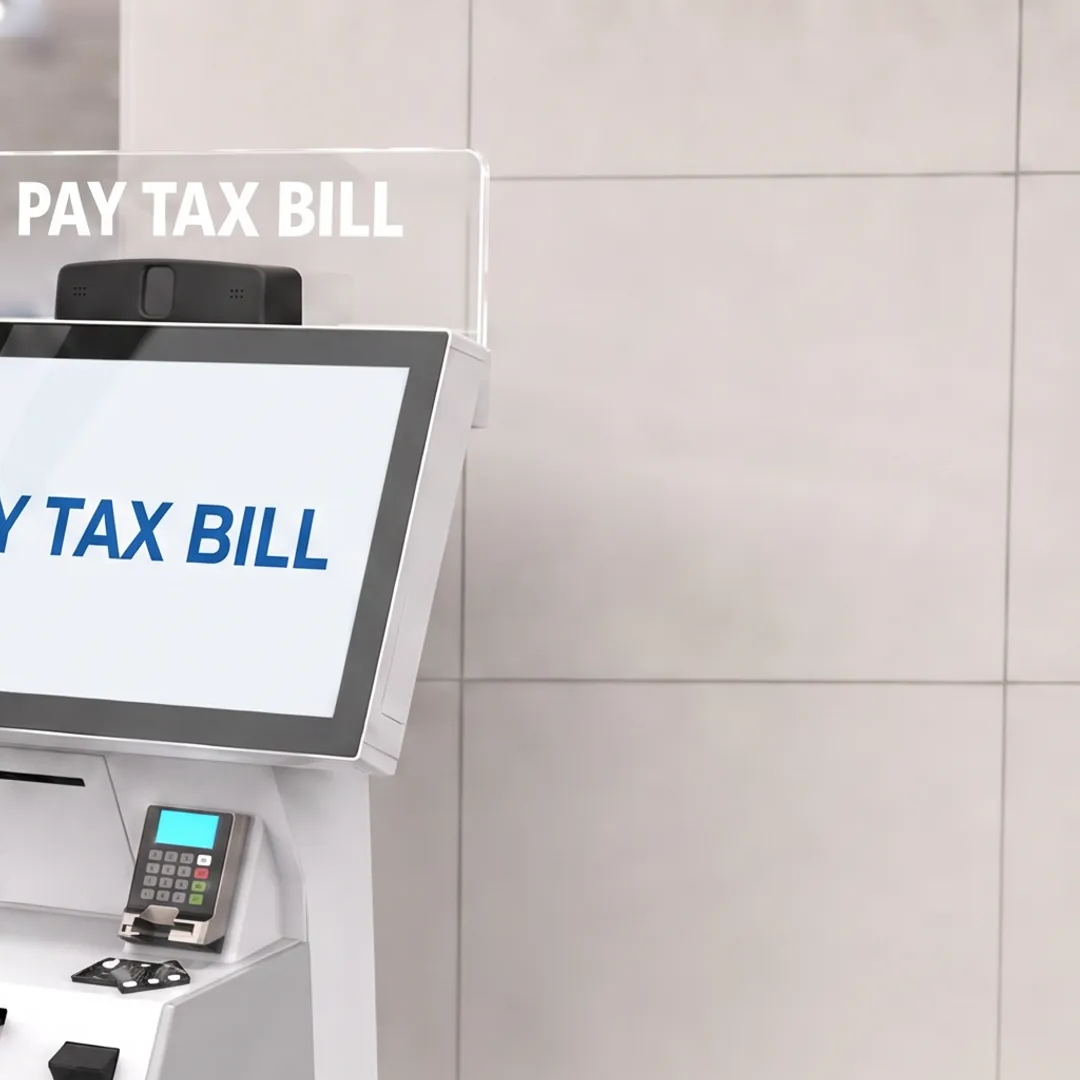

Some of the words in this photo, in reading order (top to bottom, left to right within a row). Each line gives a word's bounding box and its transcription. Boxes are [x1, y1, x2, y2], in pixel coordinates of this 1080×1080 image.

[18, 181, 127, 236] PAY
[142, 181, 259, 237] TAX
[278, 181, 403, 237] BILL
[46, 496, 173, 562] TAX
[186, 503, 328, 571] BILL
